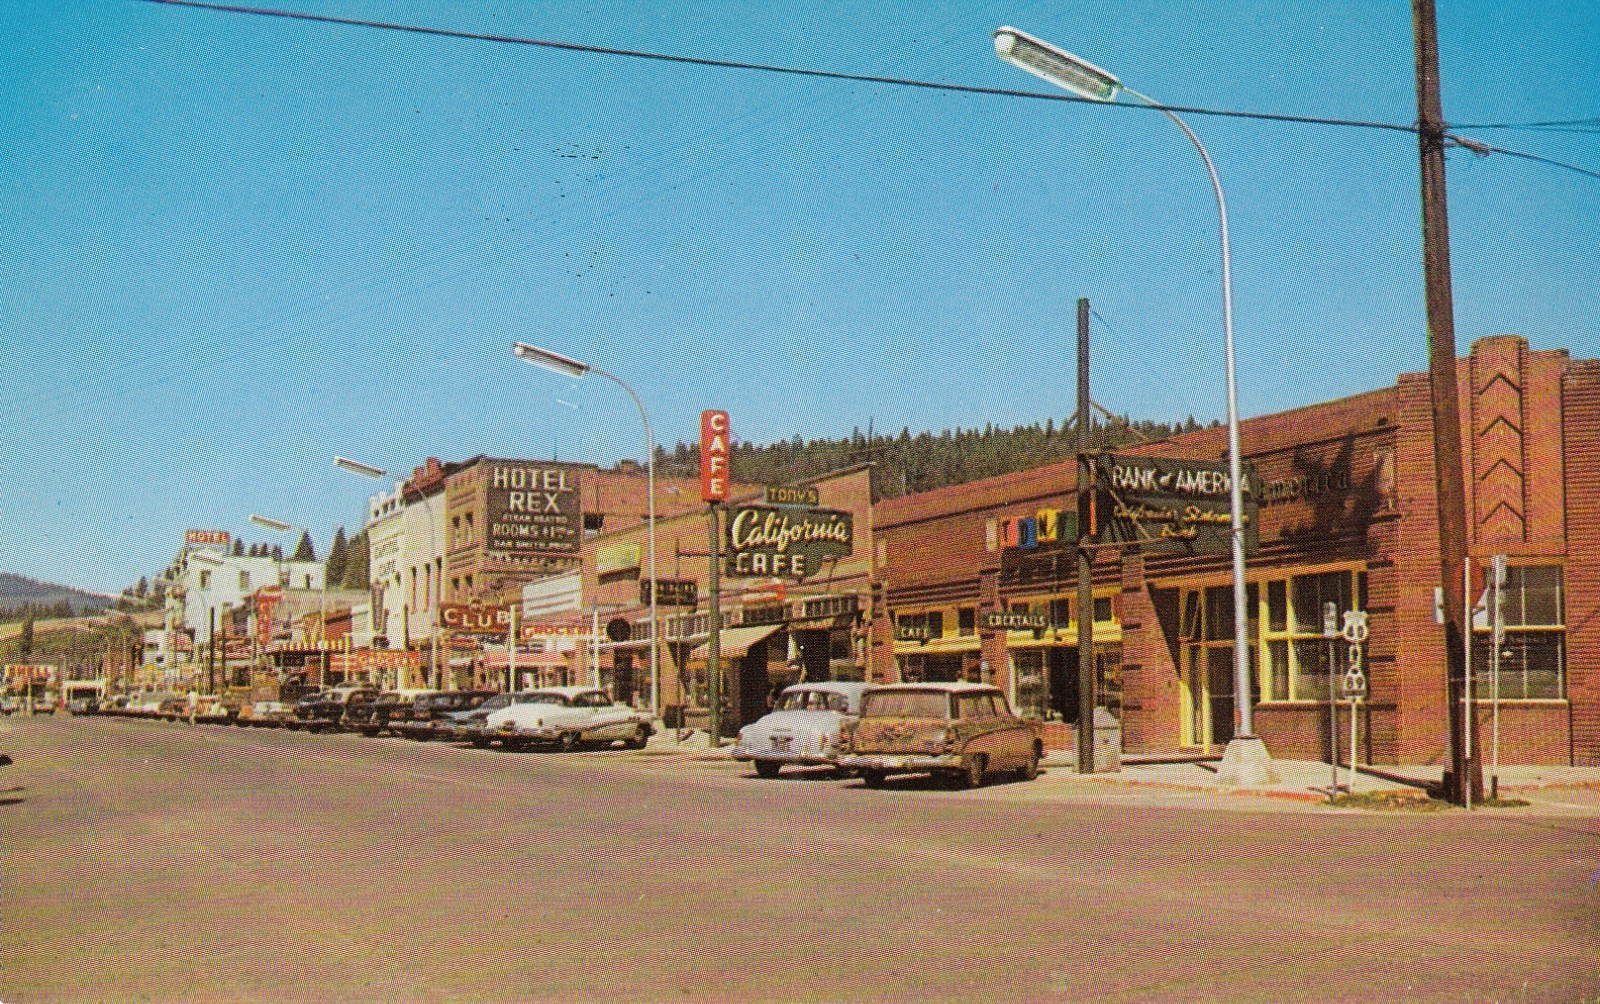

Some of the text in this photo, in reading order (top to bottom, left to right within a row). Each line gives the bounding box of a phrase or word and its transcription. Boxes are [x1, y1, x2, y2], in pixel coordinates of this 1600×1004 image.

[710, 413, 725, 496] CAFE
[493, 466, 574, 492] HOTEL
[1112, 465, 1159, 492] BANK
[1175, 469, 1250, 496] AMERIA
[509, 491, 561, 514] REX
[492, 523, 539, 538] ROOMS
[731, 509, 849, 552] California
[736, 552, 805, 576] CAFE
[443, 608, 510, 629] CLUB
[988, 614, 1047, 627] COCKTAILS
